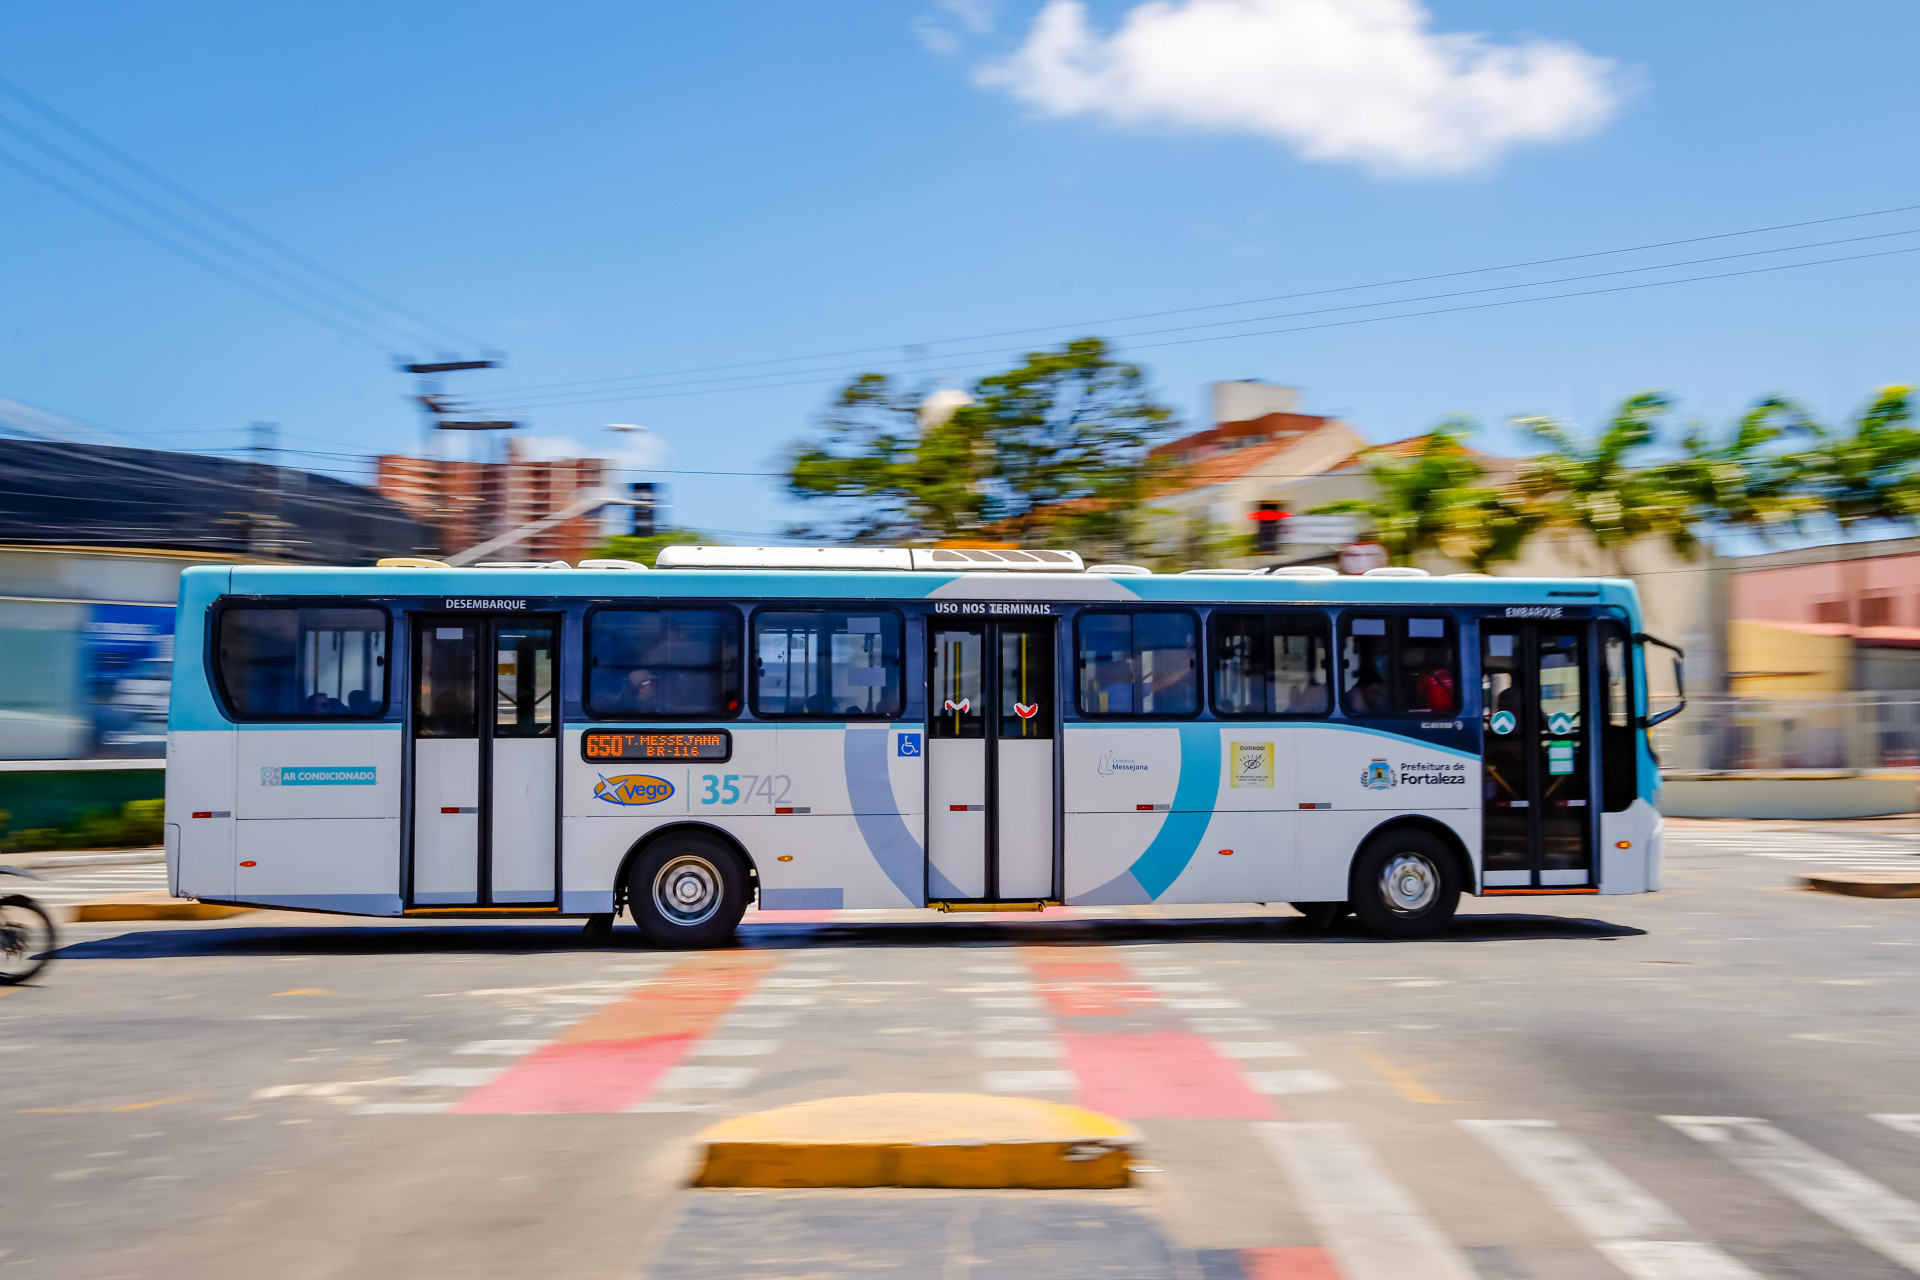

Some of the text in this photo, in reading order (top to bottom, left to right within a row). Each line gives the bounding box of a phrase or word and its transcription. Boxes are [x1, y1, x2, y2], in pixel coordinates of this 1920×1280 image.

[445, 599, 526, 610] DESEMBARQUE
[935, 603, 1051, 614] USO NOS TERMINAIS
[1505, 607, 1563, 618] EMBARQUE
[587, 735, 623, 756] 650
[625, 735, 720, 745] T.MESSEJANA
[646, 746, 700, 756] BR-116
[1112, 763, 1148, 771] Messejana
[282, 772, 375, 781] AR CONDICIONADO
[1401, 773, 1465, 784] Fortaleza
[624, 784, 668, 800] Vega
